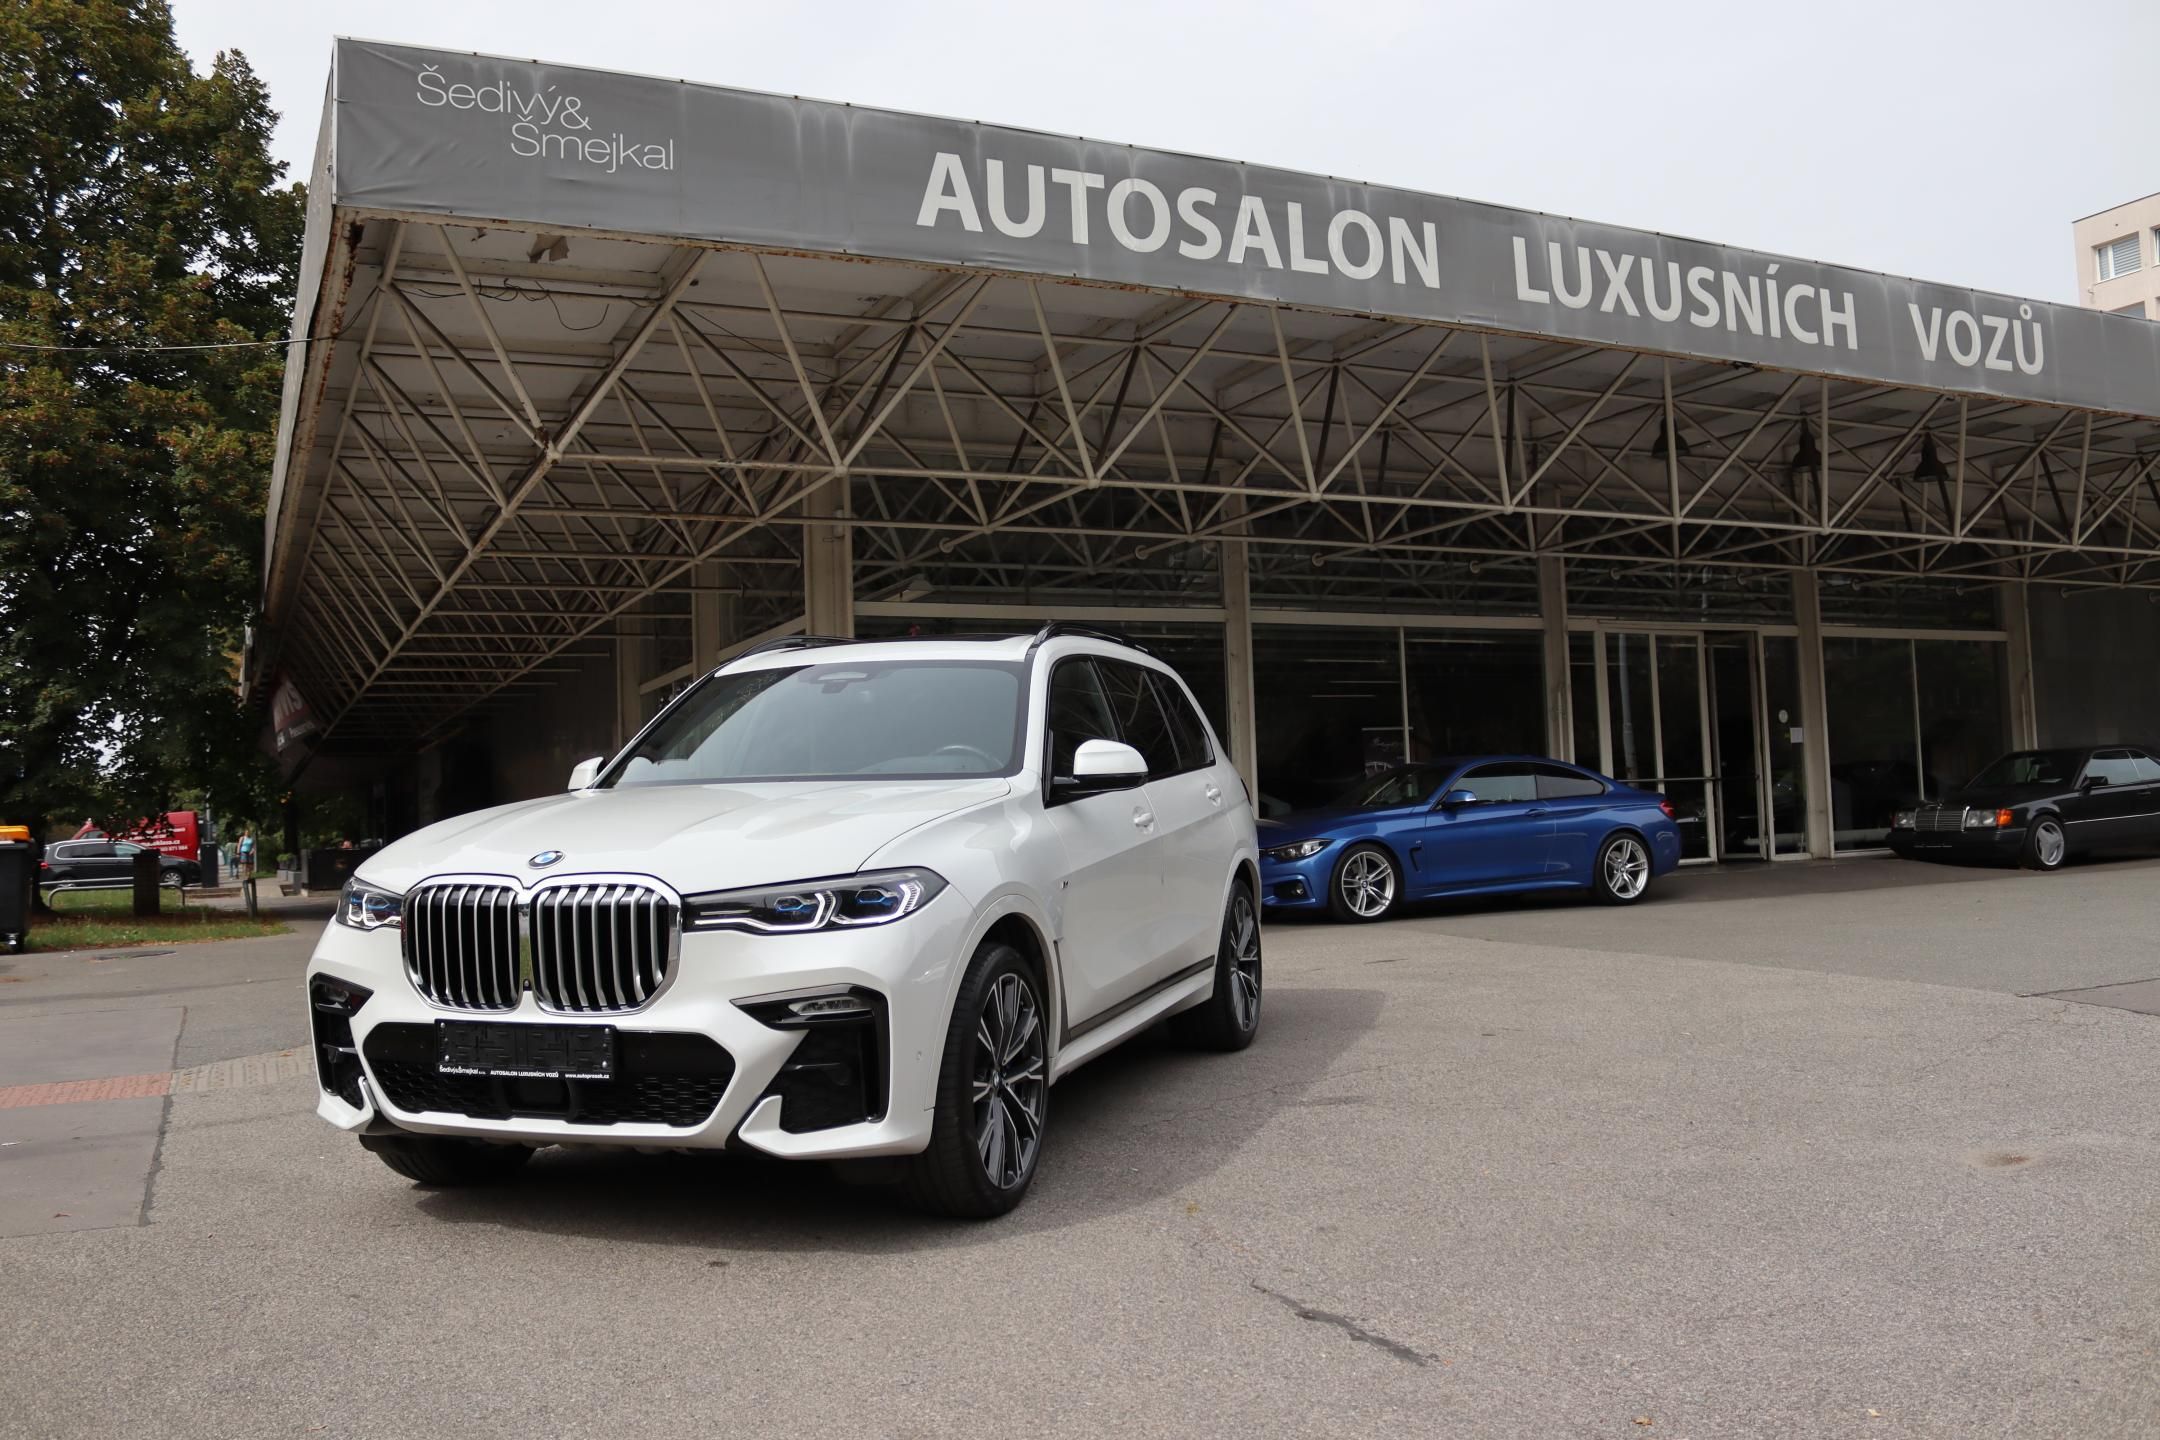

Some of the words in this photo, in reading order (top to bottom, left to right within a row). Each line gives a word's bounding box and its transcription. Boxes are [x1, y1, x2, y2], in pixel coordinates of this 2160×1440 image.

[416, 63, 592, 131] Šedivý&
[511, 115, 674, 173] Šmejkal
[916, 152, 1441, 290] AUTOSALON
[1512, 236, 1859, 351] LUXUSNÍCH
[1908, 304, 2045, 375] VOZŮ
[490, 1069, 518, 1077] AUTOSALON
